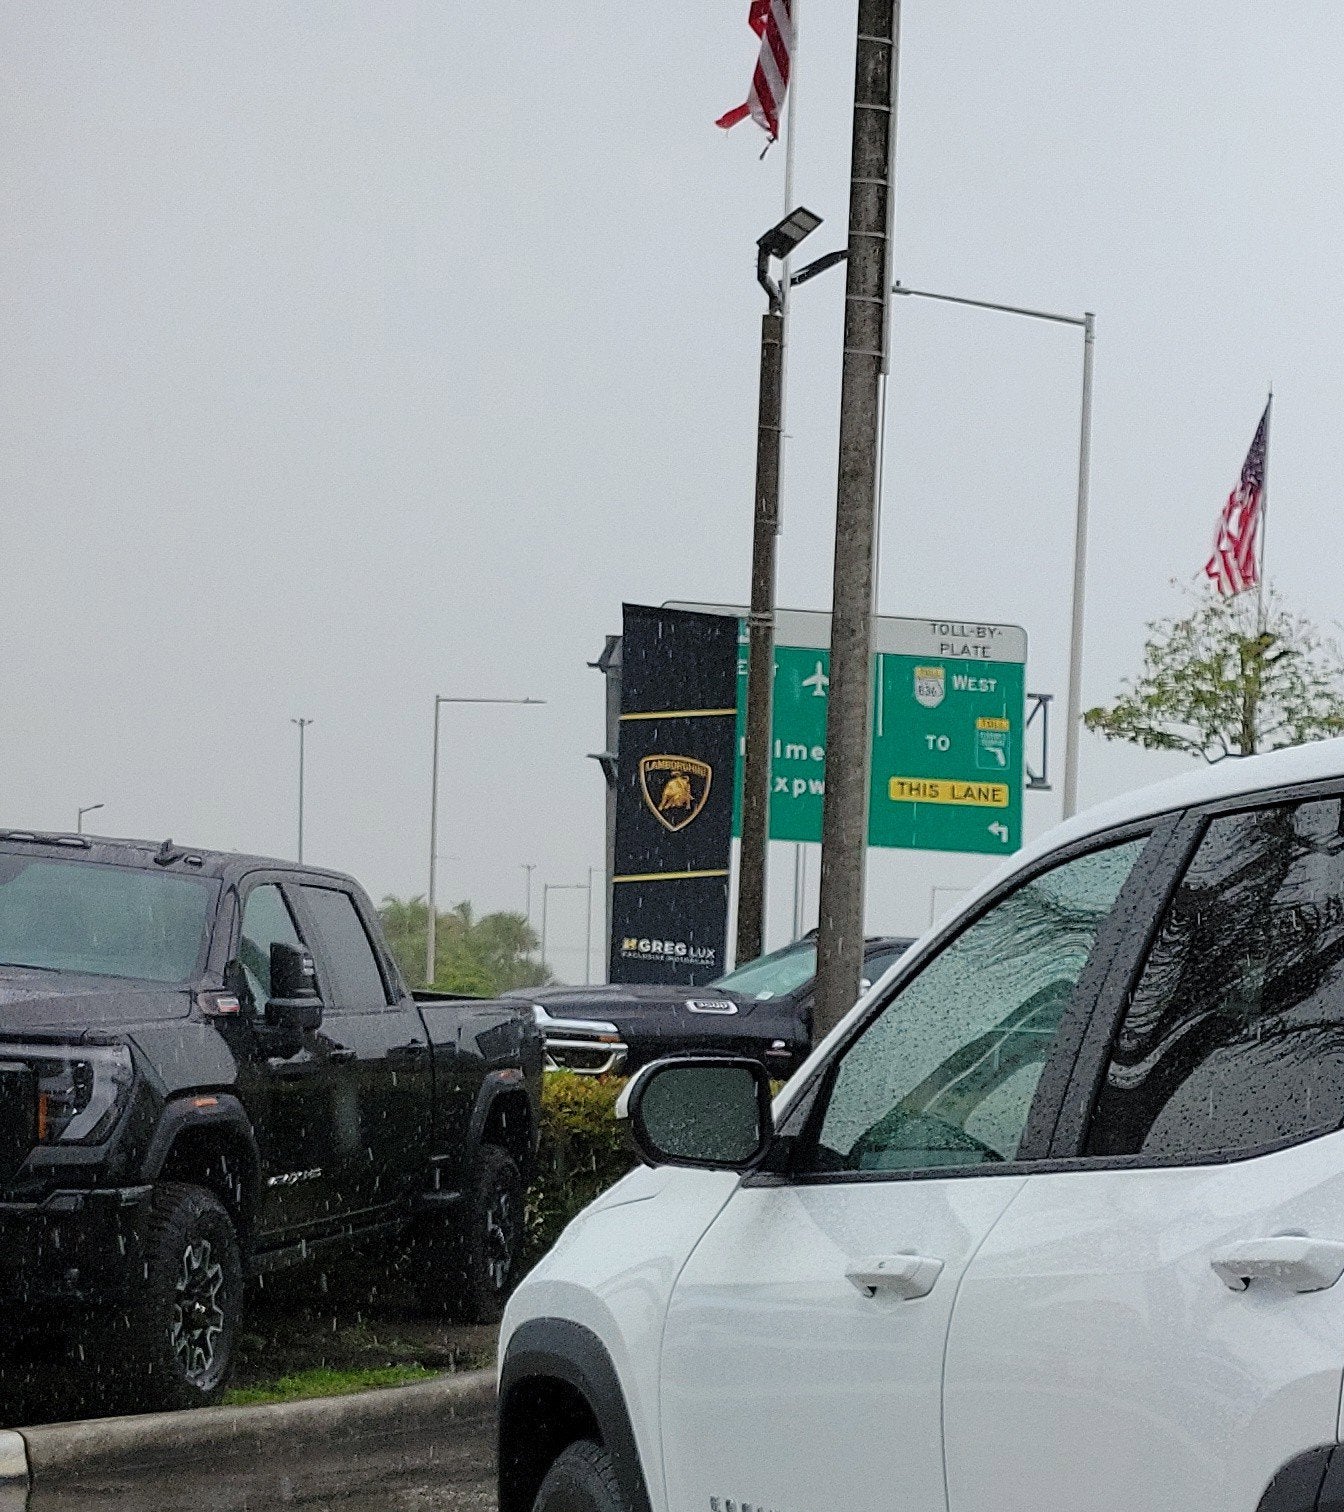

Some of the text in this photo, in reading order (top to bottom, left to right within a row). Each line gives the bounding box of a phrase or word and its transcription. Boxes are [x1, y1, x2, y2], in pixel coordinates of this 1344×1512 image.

[930, 623, 1002, 638] TOLL-BY-
[940, 643, 991, 658] PLATE
[952, 674, 998, 692] WEST
[925, 733, 951, 752] TO
[898, 781, 1004, 803] THIS LANE
[689, 946, 716, 960] LUX
